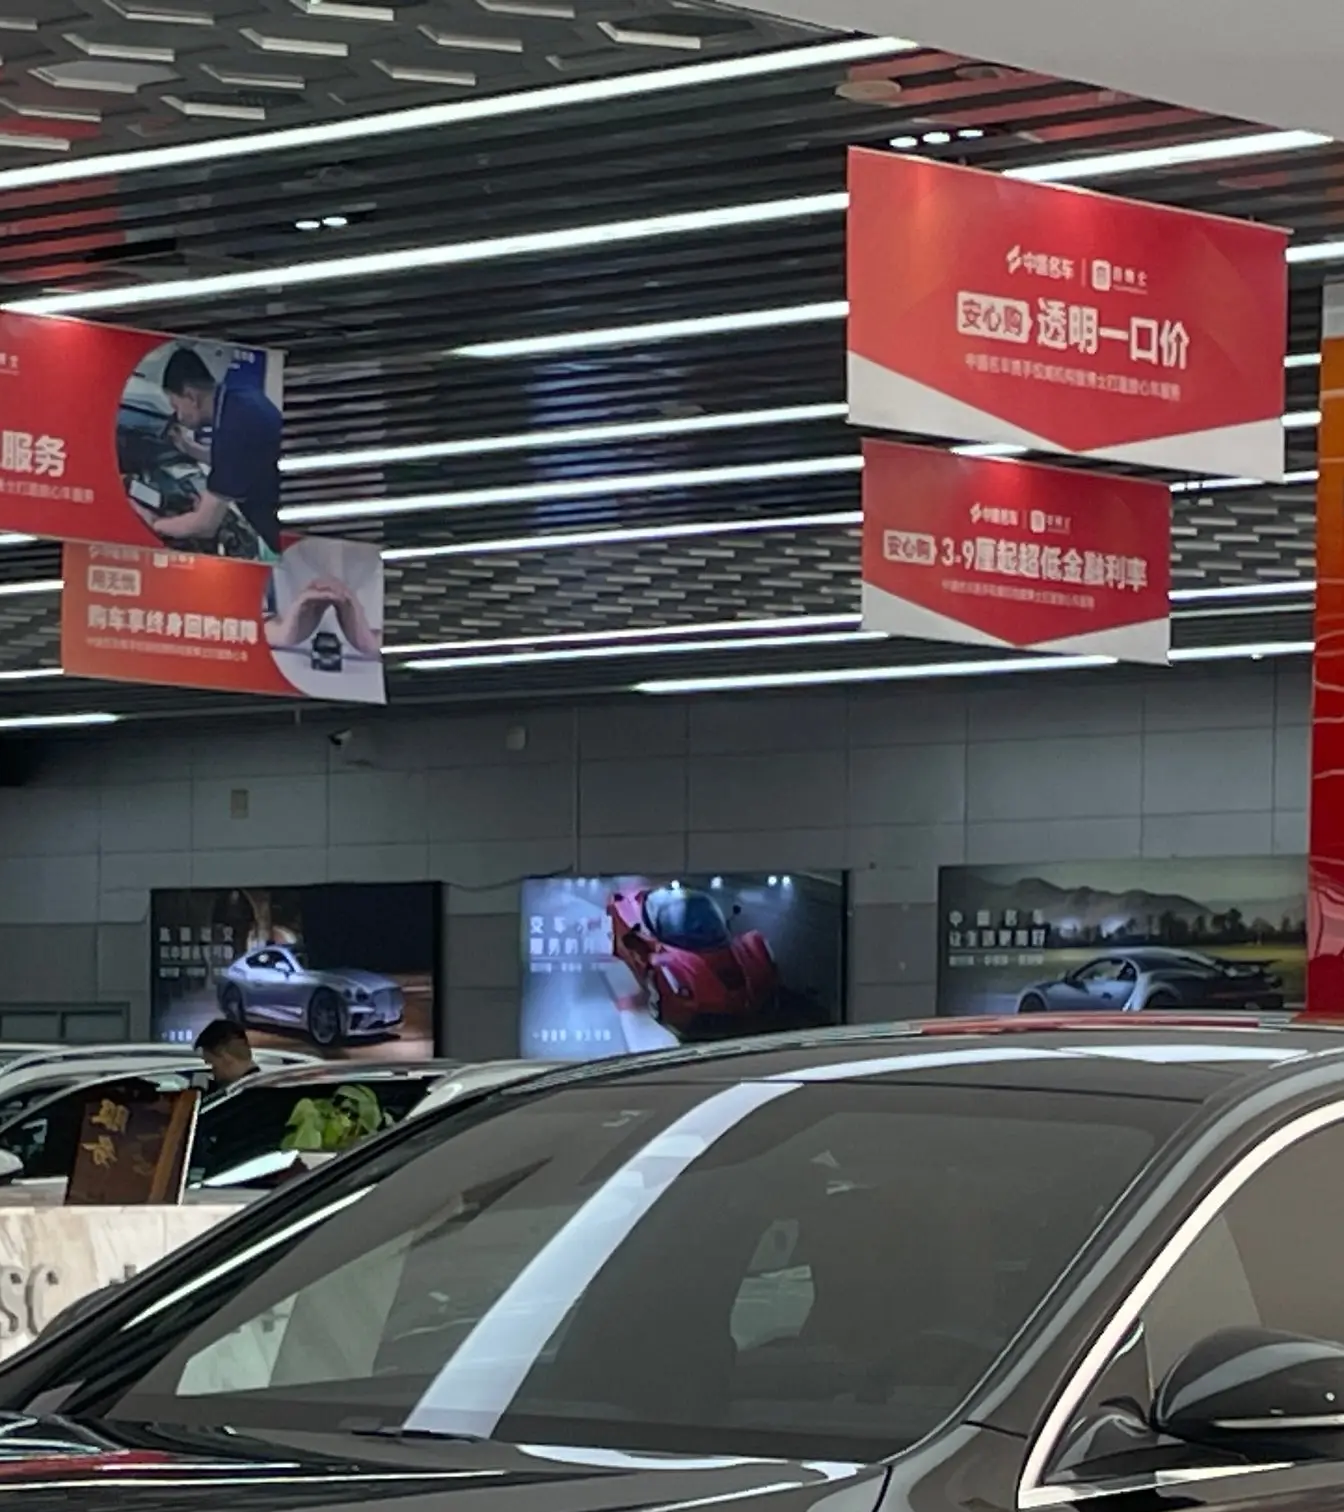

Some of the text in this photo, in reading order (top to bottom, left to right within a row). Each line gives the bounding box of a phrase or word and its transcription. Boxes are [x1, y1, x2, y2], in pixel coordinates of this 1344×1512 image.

[962, 298, 1190, 369] 安心购 透明一口价
